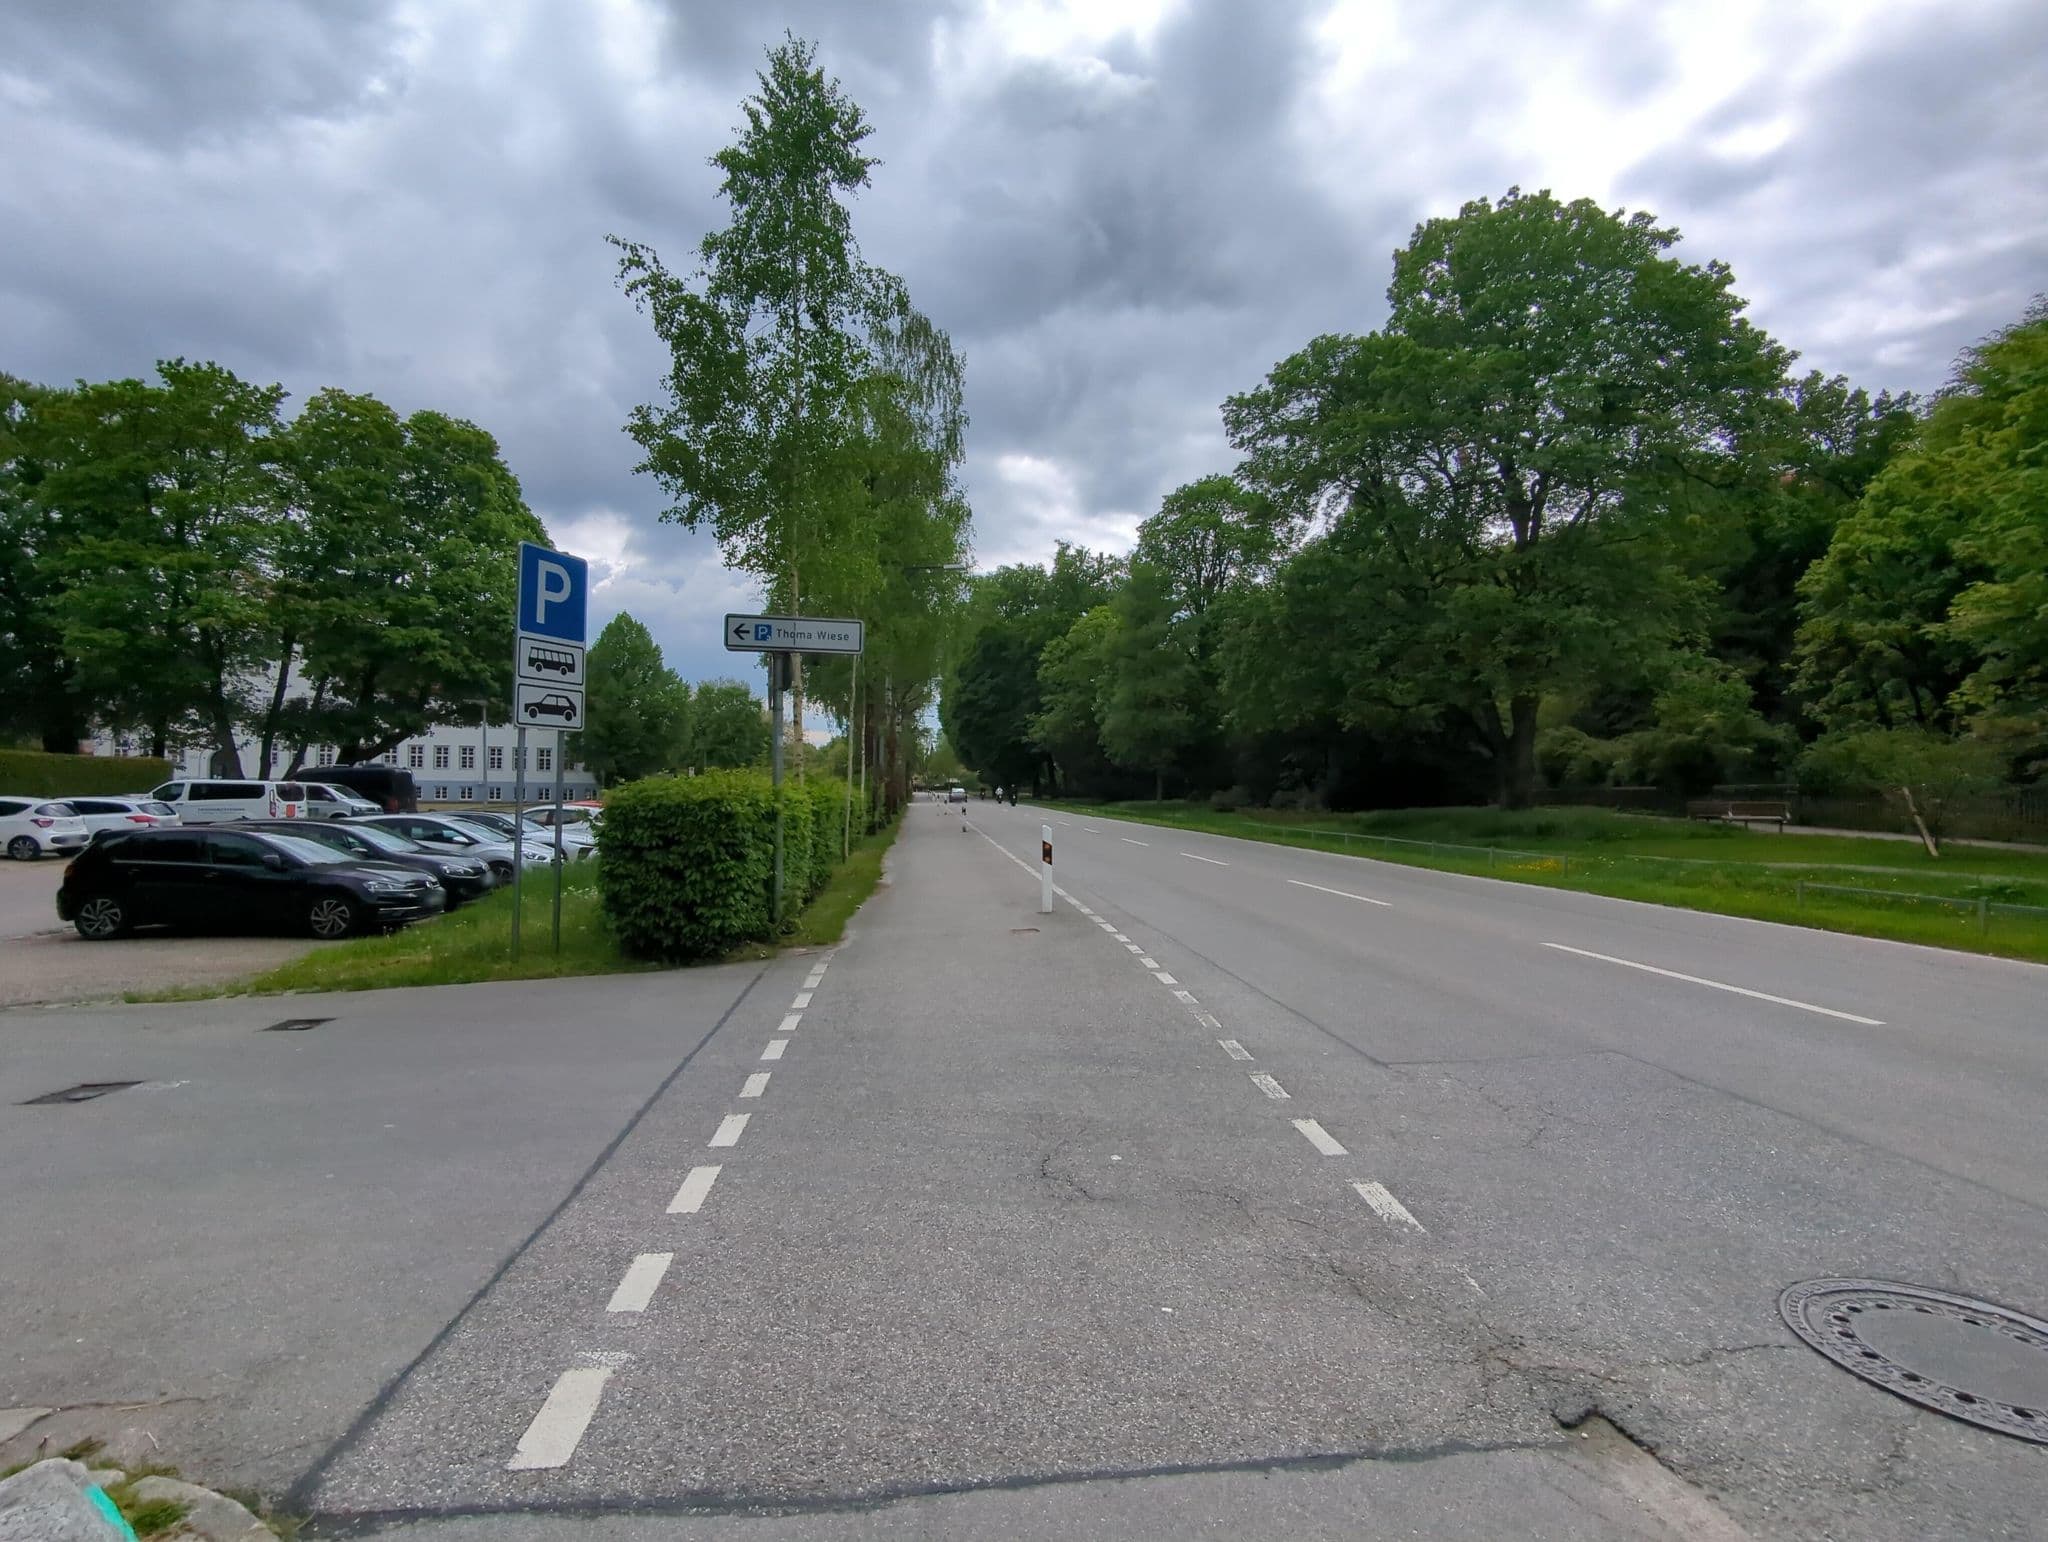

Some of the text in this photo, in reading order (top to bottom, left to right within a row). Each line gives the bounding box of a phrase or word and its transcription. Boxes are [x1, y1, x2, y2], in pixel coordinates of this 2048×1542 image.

[536, 559, 572, 625] P
[777, 628, 813, 640] Thoma
[817, 630, 850, 641] Wiese
